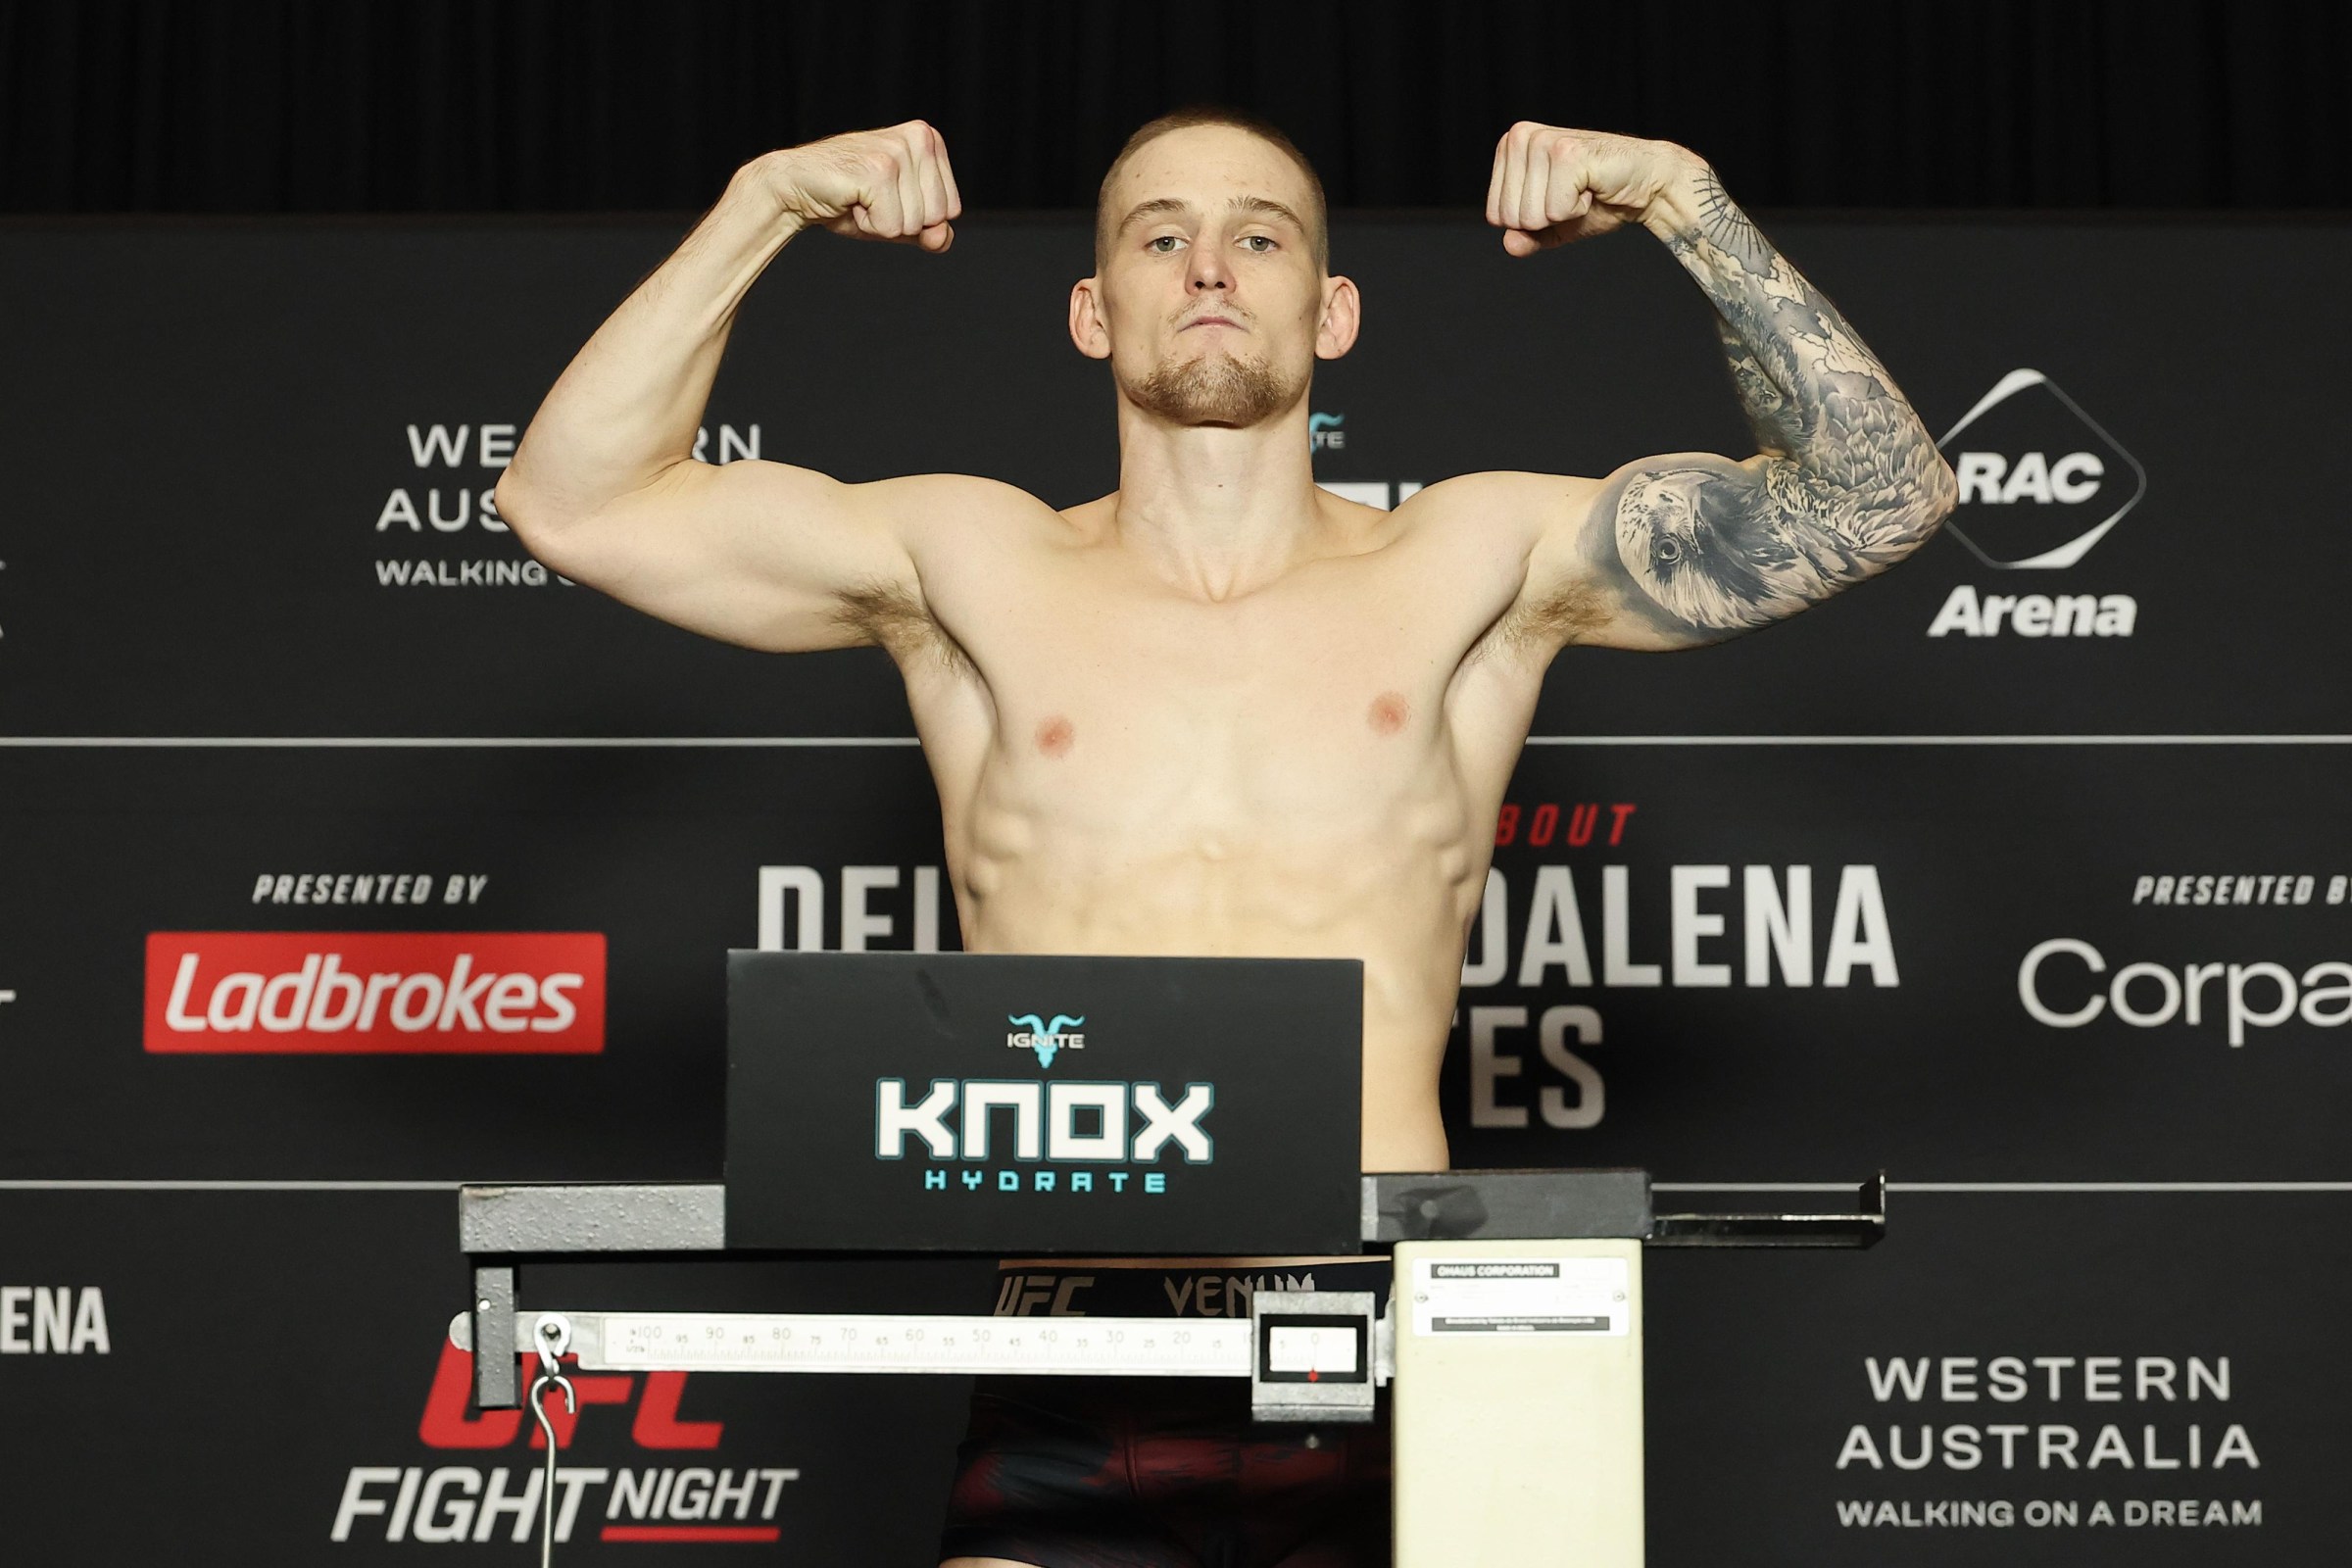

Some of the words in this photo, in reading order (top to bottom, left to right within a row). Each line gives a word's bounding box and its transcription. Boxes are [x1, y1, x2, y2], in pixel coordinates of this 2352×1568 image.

[1956, 452, 2104, 504] RAC
[375, 560, 547, 586] WALKING
[1927, 585, 2137, 637] Arena
[1495, 804, 1637, 846] BOUT
[252, 874, 433, 904] PRESENTED
[443, 874, 488, 904] BY
[2132, 875, 2315, 906] PRESENTED
[2326, 875, 2352, 906] B
[166, 953, 584, 1032] Ladbrokes
[2018, 938, 2352, 1048] Corpa
[1006, 1032, 1085, 1049] IGNITE
[1452, 1005, 1605, 1128] ES
[875, 1077, 1214, 1164] KNOX
[924, 1169, 1166, 1194] HYDRATE
[1437, 1265, 1476, 1277] OHAUS
[1477, 1265, 1554, 1277] CORPORATION
[994, 1276, 1095, 1316] UFC
[0, 1286, 111, 1353] ENA
[706, 1327, 724, 1340] 90
[772, 1327, 791, 1341] 80
[841, 1328, 858, 1341] 70
[906, 1329, 924, 1342] 60
[972, 1330, 991, 1343] 50
[1039, 1330, 1057, 1343] 40
[1106, 1330, 1124, 1344] 30
[1173, 1331, 1191, 1345] 20
[1311, 1332, 1320, 1345] 0
[1865, 1356, 2230, 1402] WESTERN
[1836, 1424, 2261, 1470] AUSTRALIA
[330, 1467, 609, 1543] FIGHT
[606, 1468, 800, 1520] NIGHT
[1836, 1499, 2014, 1528] WALKING
[2024, 1499, 2078, 1528] ON
[2087, 1499, 2116, 1528] A
[2124, 1499, 2262, 1528] DREAM
